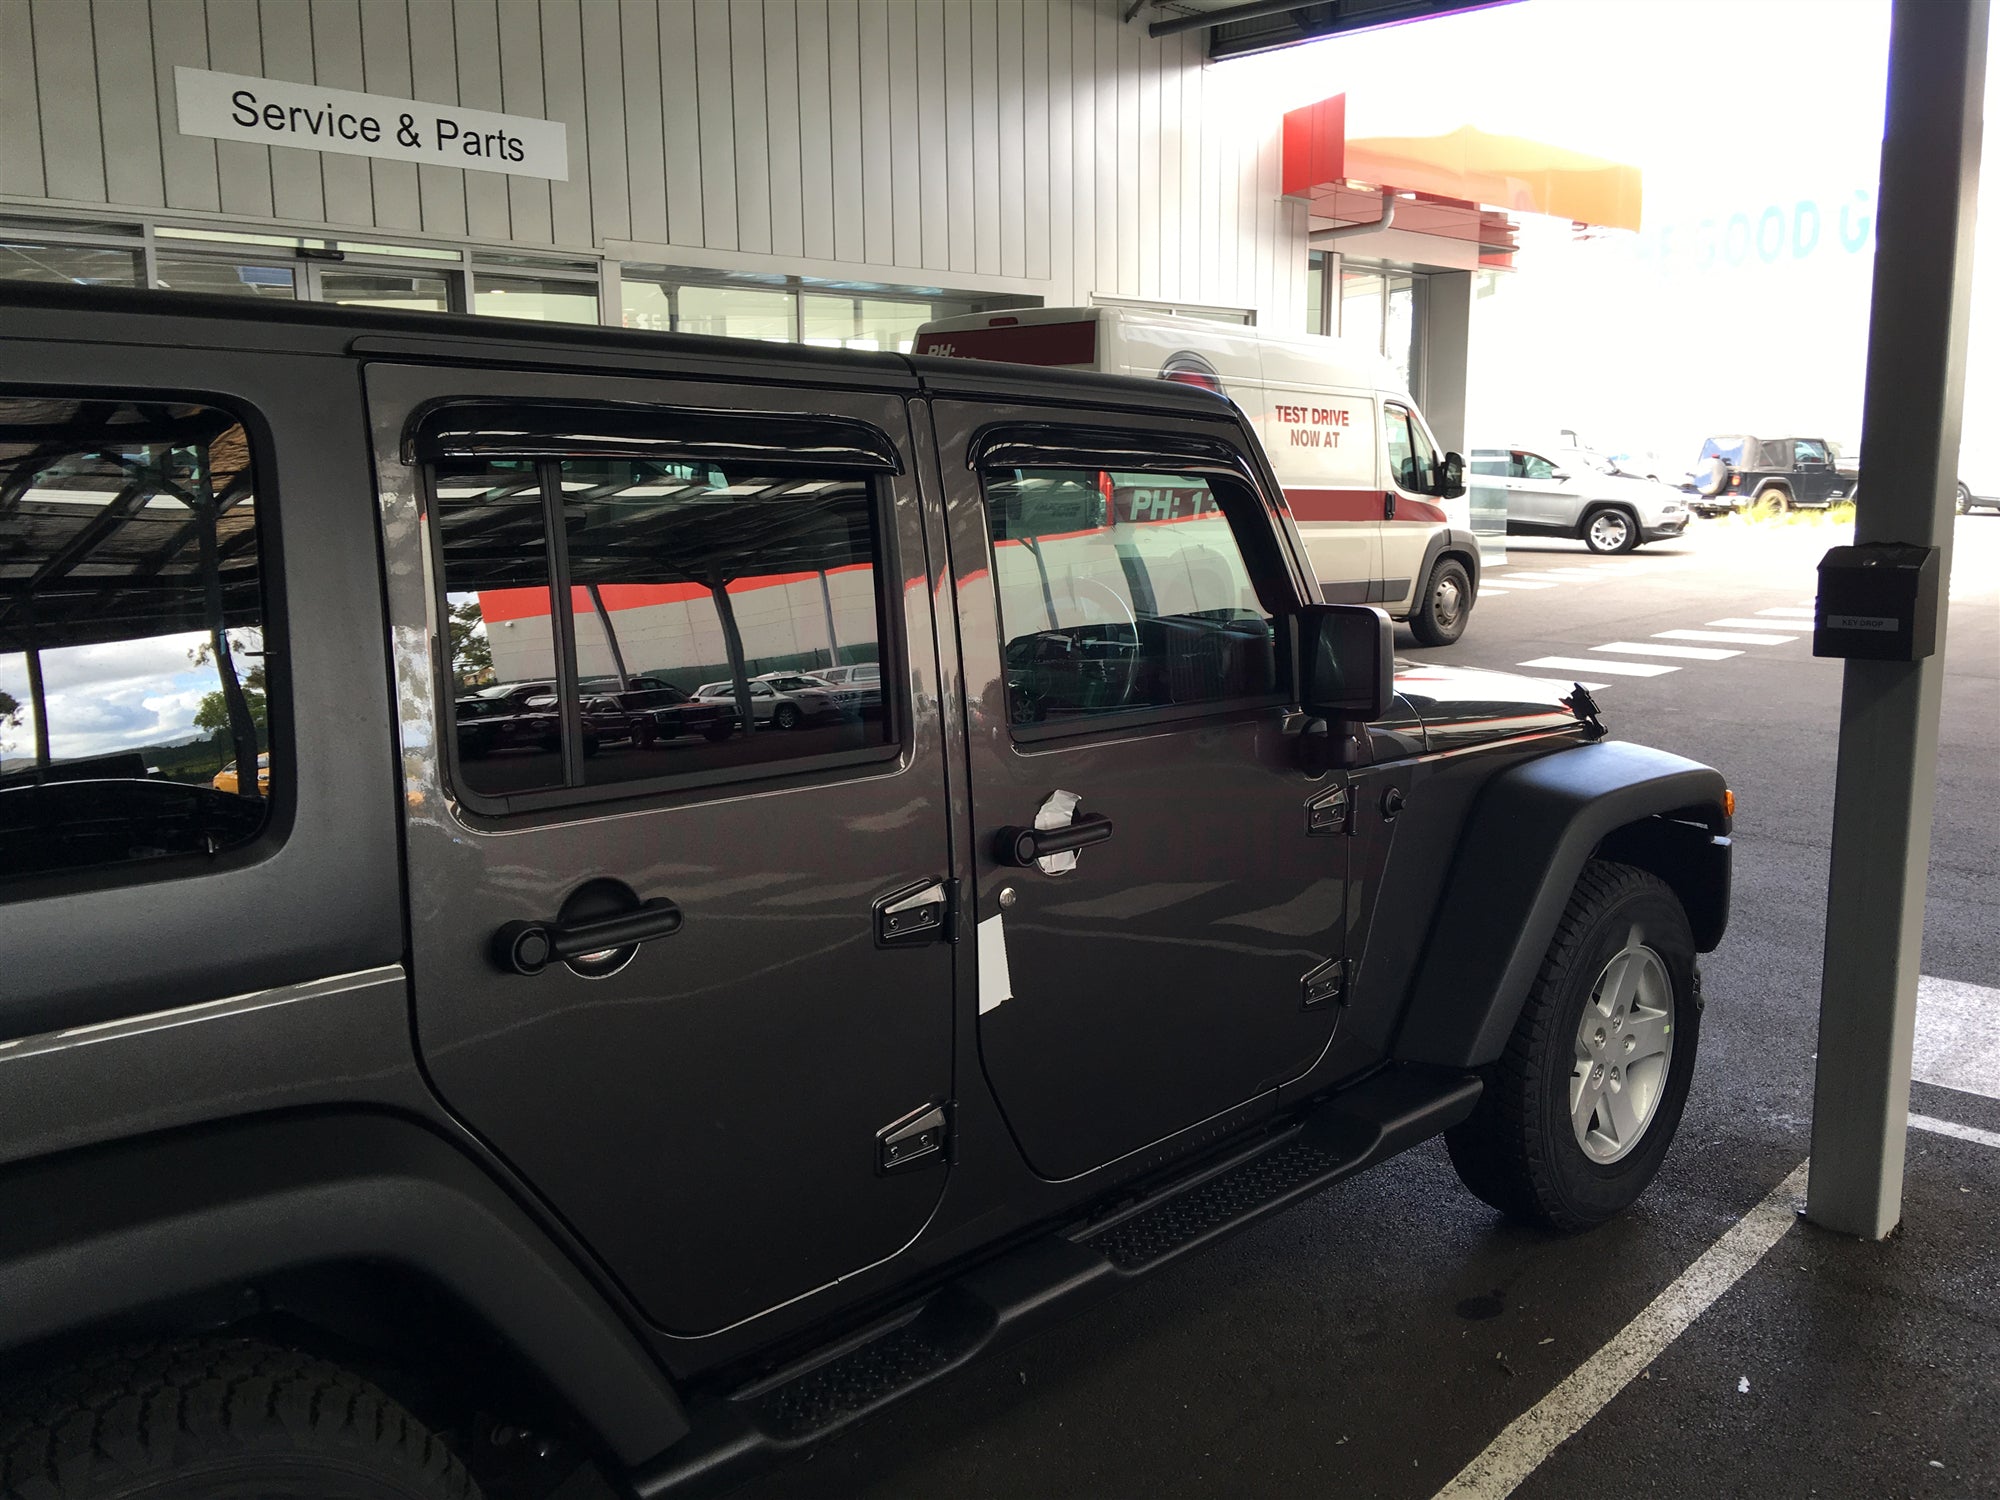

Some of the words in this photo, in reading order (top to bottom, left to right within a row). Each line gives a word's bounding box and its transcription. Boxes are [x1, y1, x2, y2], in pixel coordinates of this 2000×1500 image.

[231, 90, 381, 143] Service
[396, 112, 422, 148] &
[436, 117, 525, 162] Parts
[1696, 200, 1820, 270] GOOD
[1275, 405, 1308, 424] TEST
[1311, 408, 1350, 426] DRIVE
[1290, 429, 1320, 447] NOW
[1323, 431, 1340, 448] AT
[1129, 489, 1180, 520] PH:
[1860, 620, 1884, 628] DROP
